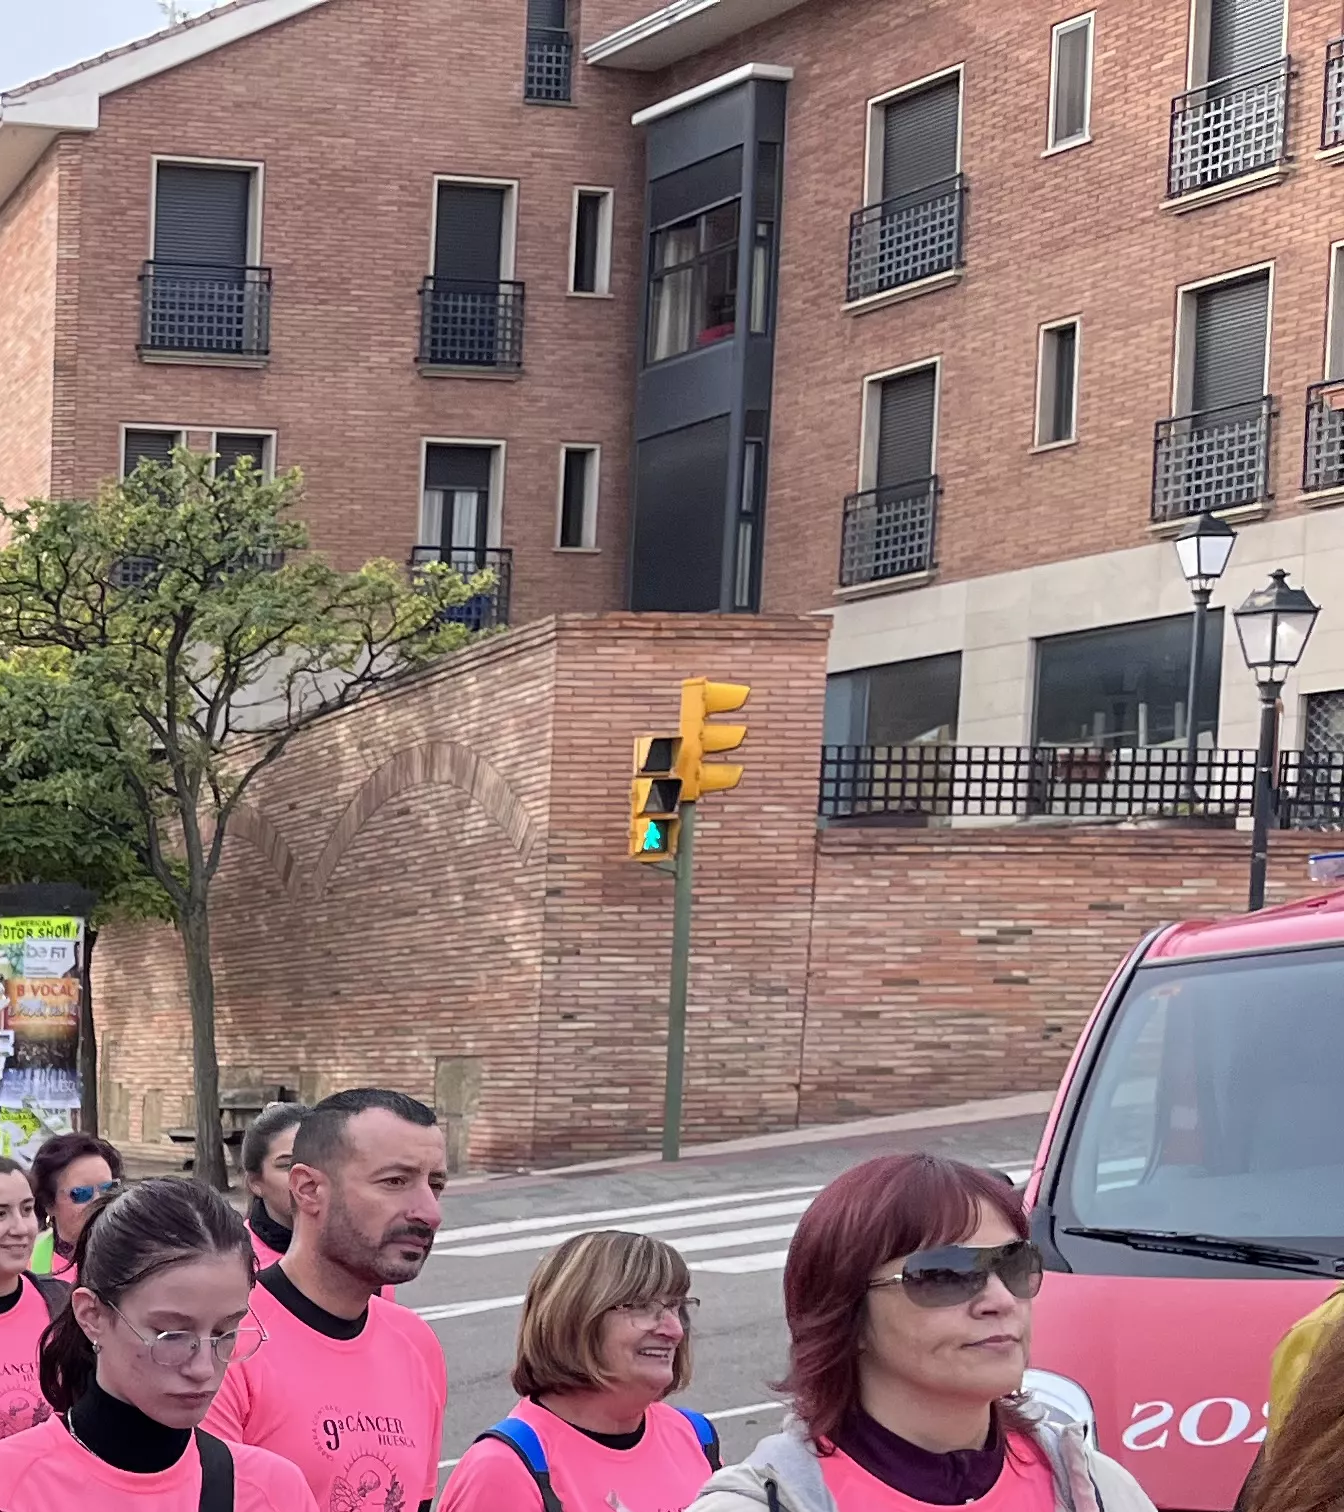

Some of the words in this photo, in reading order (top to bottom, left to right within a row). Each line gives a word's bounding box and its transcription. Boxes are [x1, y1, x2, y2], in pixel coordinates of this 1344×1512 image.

[38, 922, 72, 939] SHOW
[30, 984, 77, 997] VOCAL
[345, 1410, 405, 1434] CÁNCER
